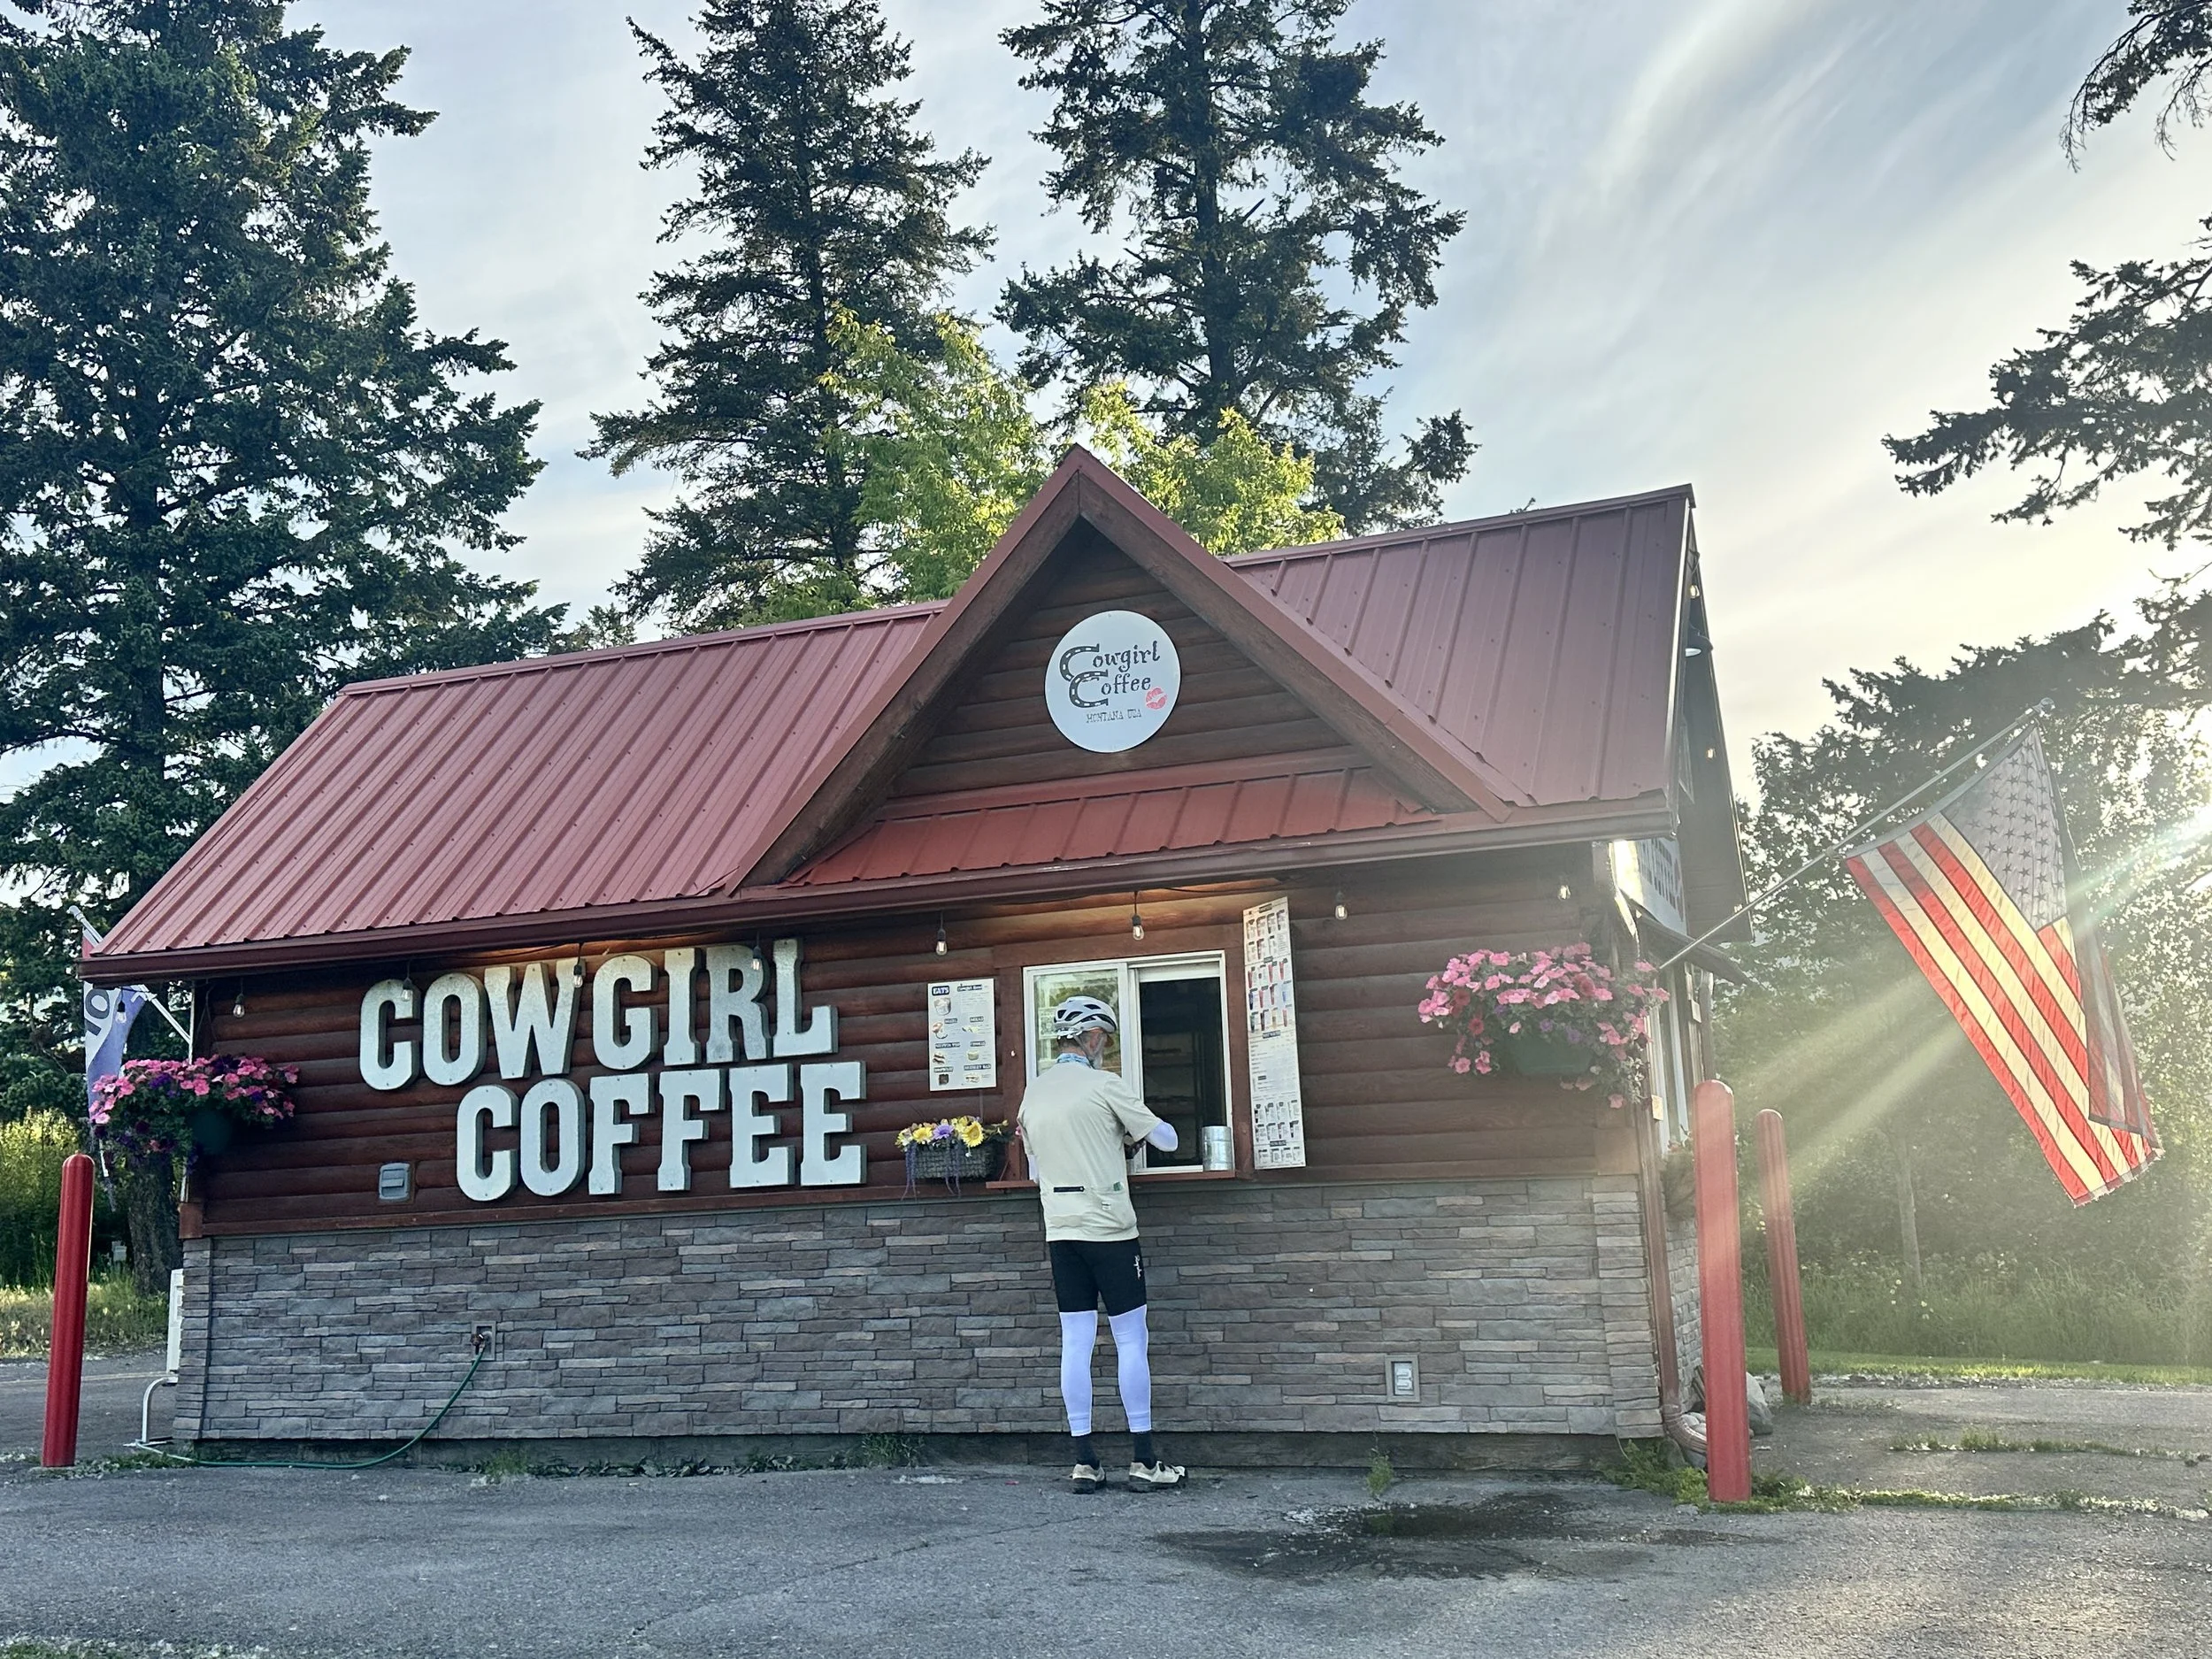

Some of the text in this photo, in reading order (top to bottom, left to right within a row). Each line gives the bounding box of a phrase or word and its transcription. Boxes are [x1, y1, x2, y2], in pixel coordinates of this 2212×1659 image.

[1060, 640, 1161, 682] Cowgirl
[1069, 669, 1152, 709] Coffee
[1086, 710, 1124, 724] MONTANA
[933, 987, 949, 995] EATS
[359, 939, 839, 1091] COWGIRL
[456, 1061, 867, 1202] COFFEE
